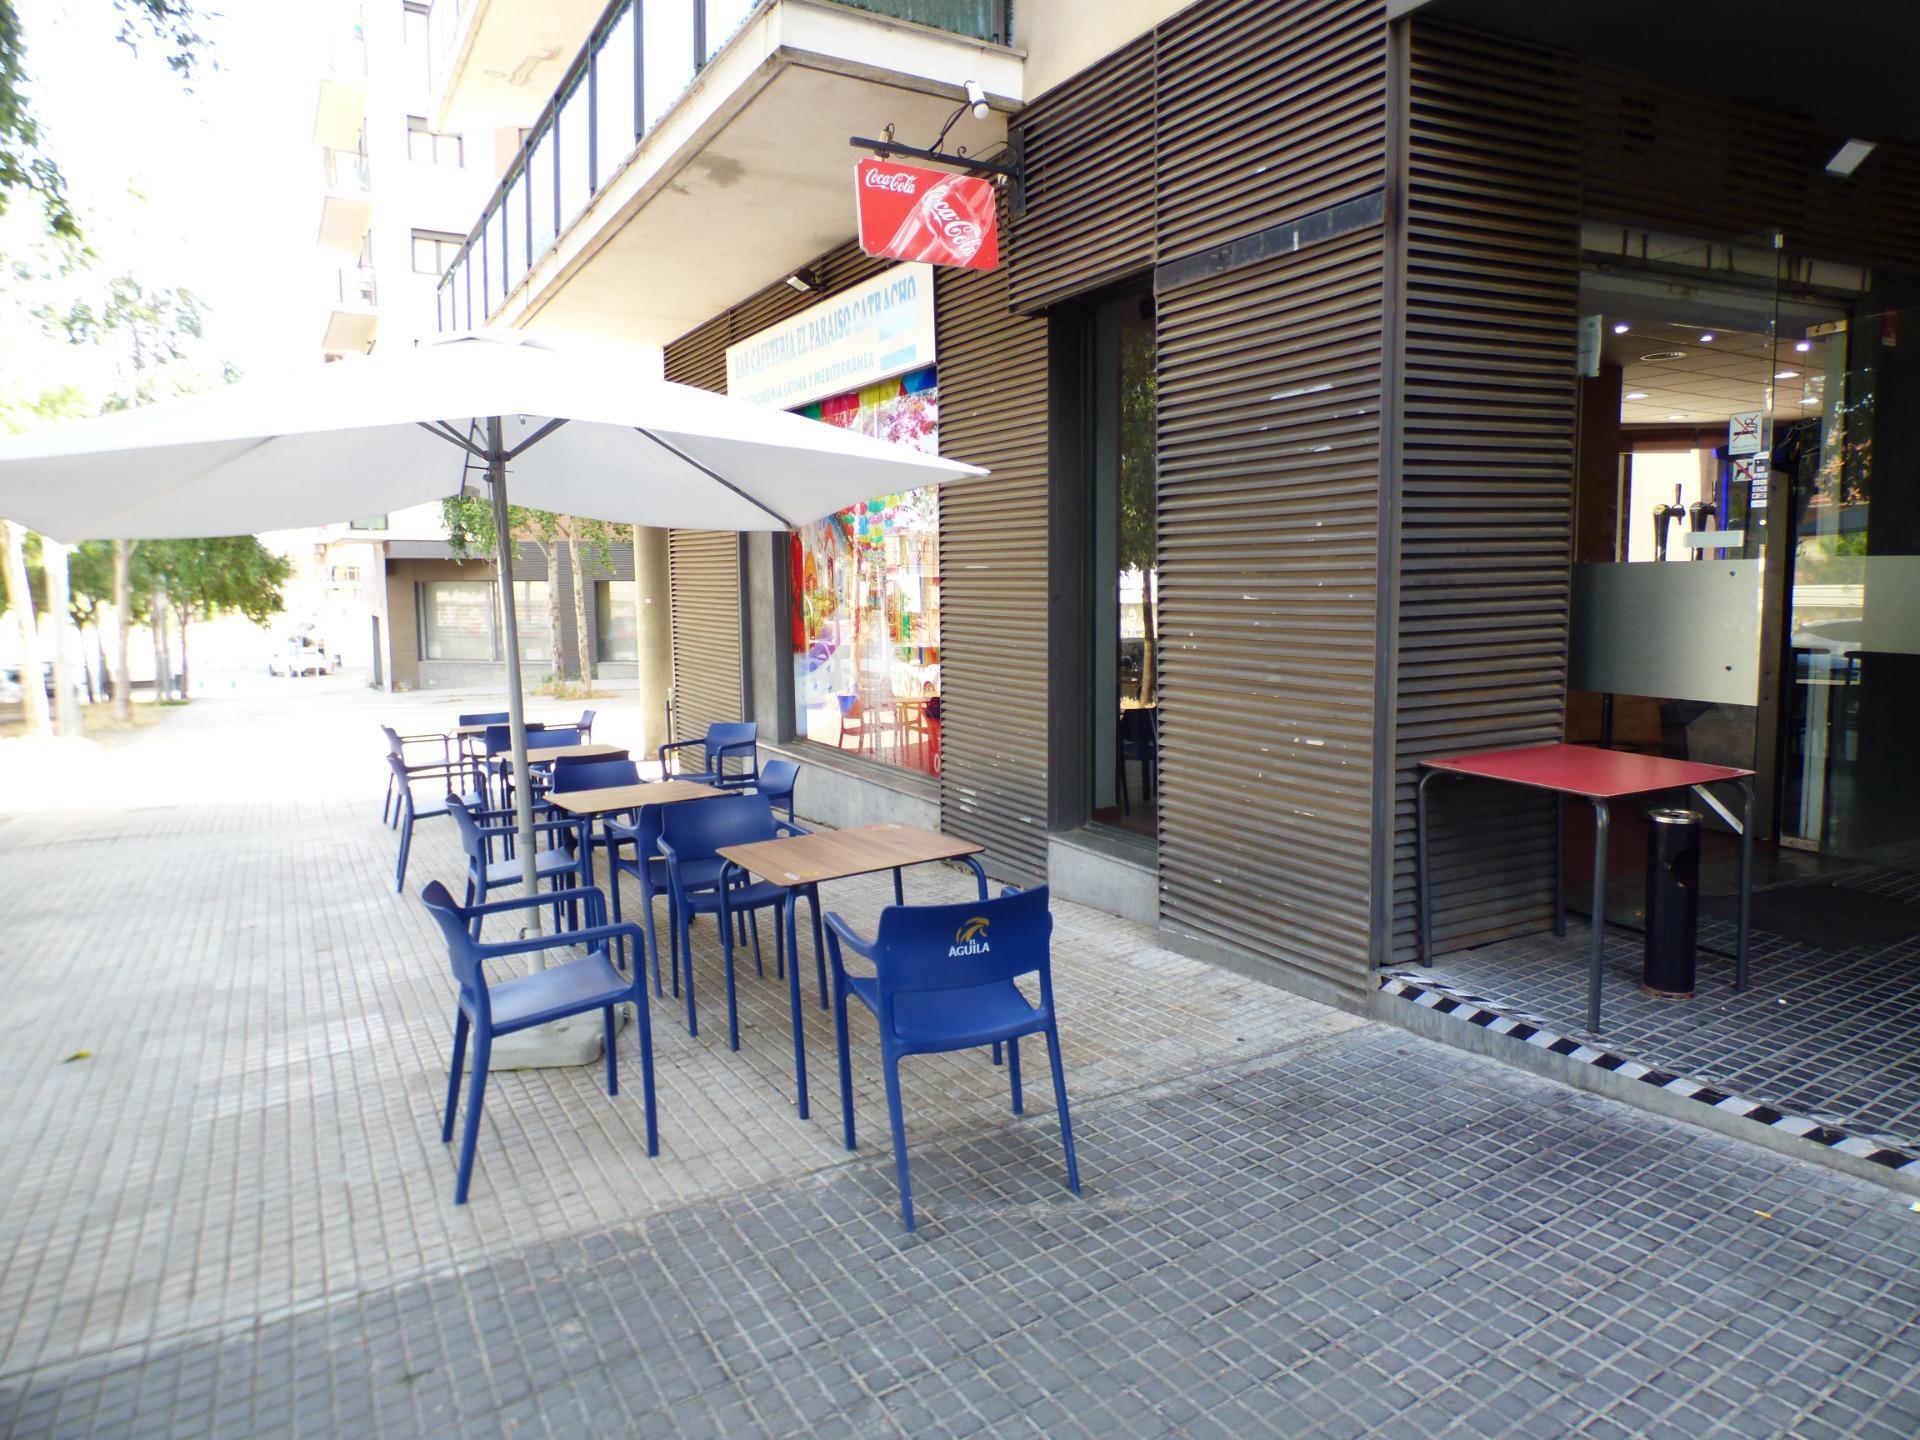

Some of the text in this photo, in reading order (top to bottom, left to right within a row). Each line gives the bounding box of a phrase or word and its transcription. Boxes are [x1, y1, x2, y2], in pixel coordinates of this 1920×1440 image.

[865, 168, 917, 194] Coca-Cola
[735, 275, 917, 380] BAR CAFETERIA EL PARAISO CATRACHO
[784, 375, 807, 397] LATINA
[815, 351, 875, 387] MEDITERRANEA
